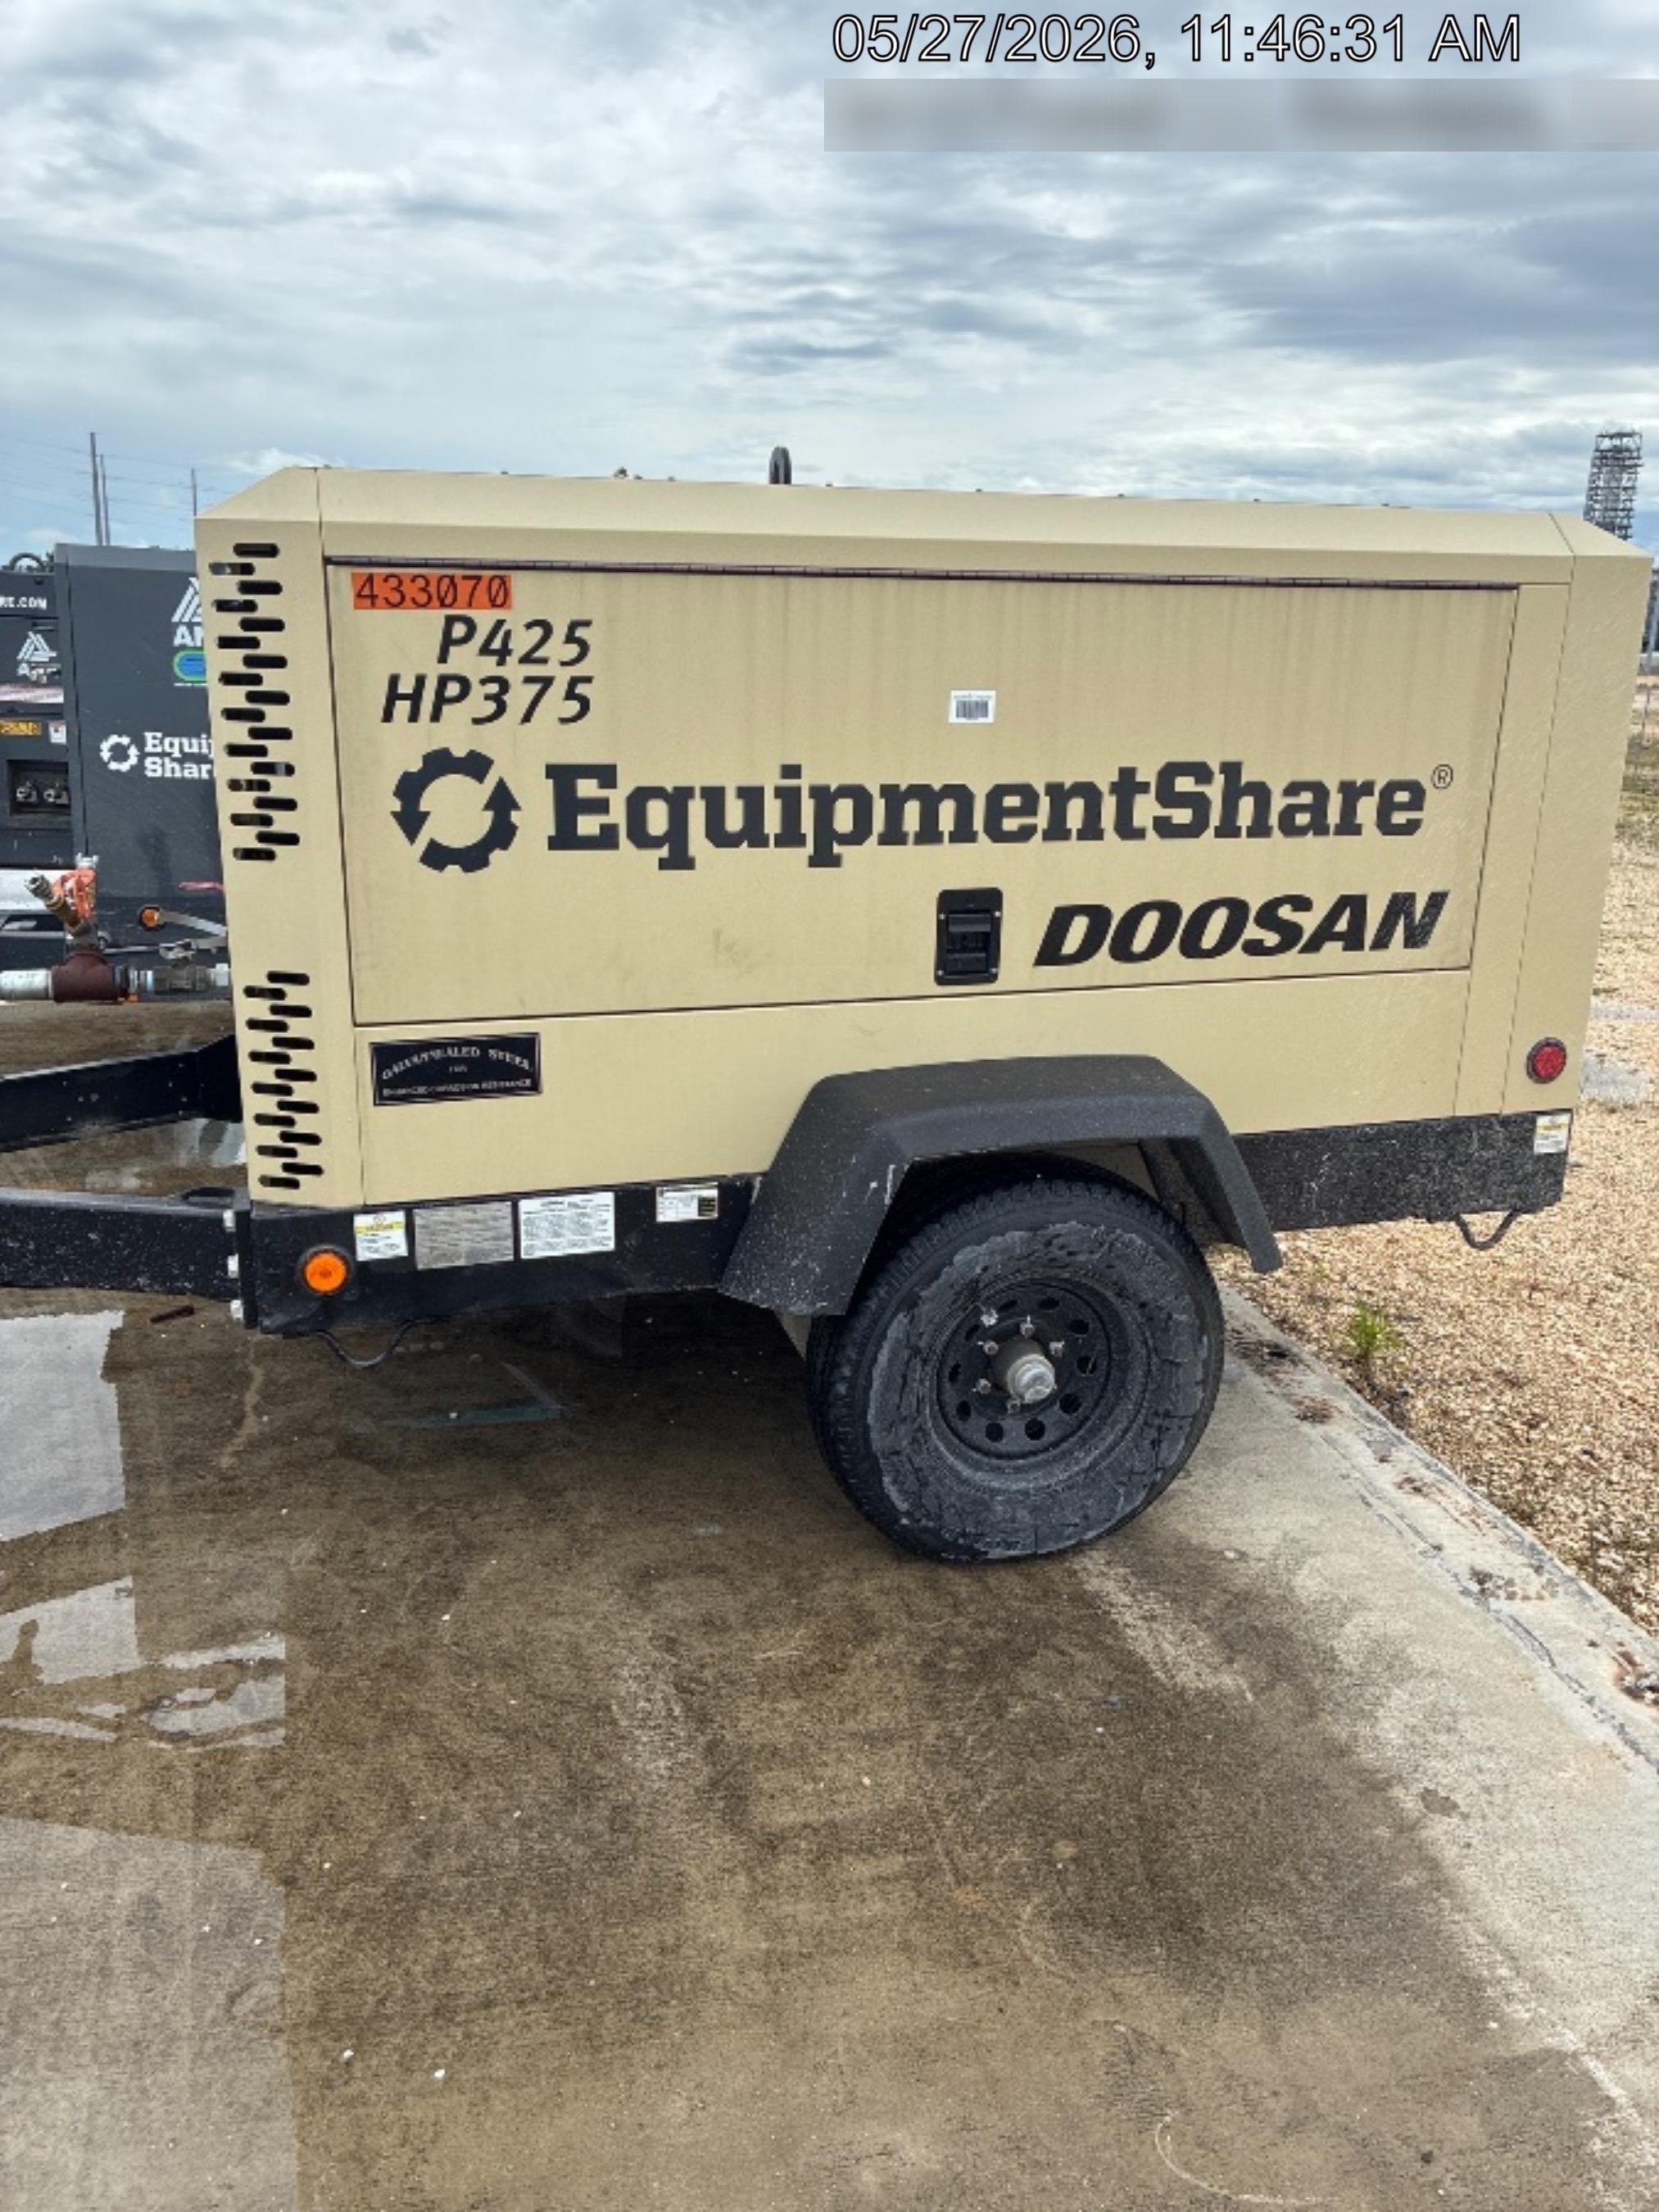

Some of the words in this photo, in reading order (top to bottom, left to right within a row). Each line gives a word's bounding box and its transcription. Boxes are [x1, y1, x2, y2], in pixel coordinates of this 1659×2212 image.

[356, 573, 510, 608] 433070
[437, 614, 593, 667] P425
[380, 673, 595, 725] HP375
[1032, 890, 1450, 968] DOOSAN
